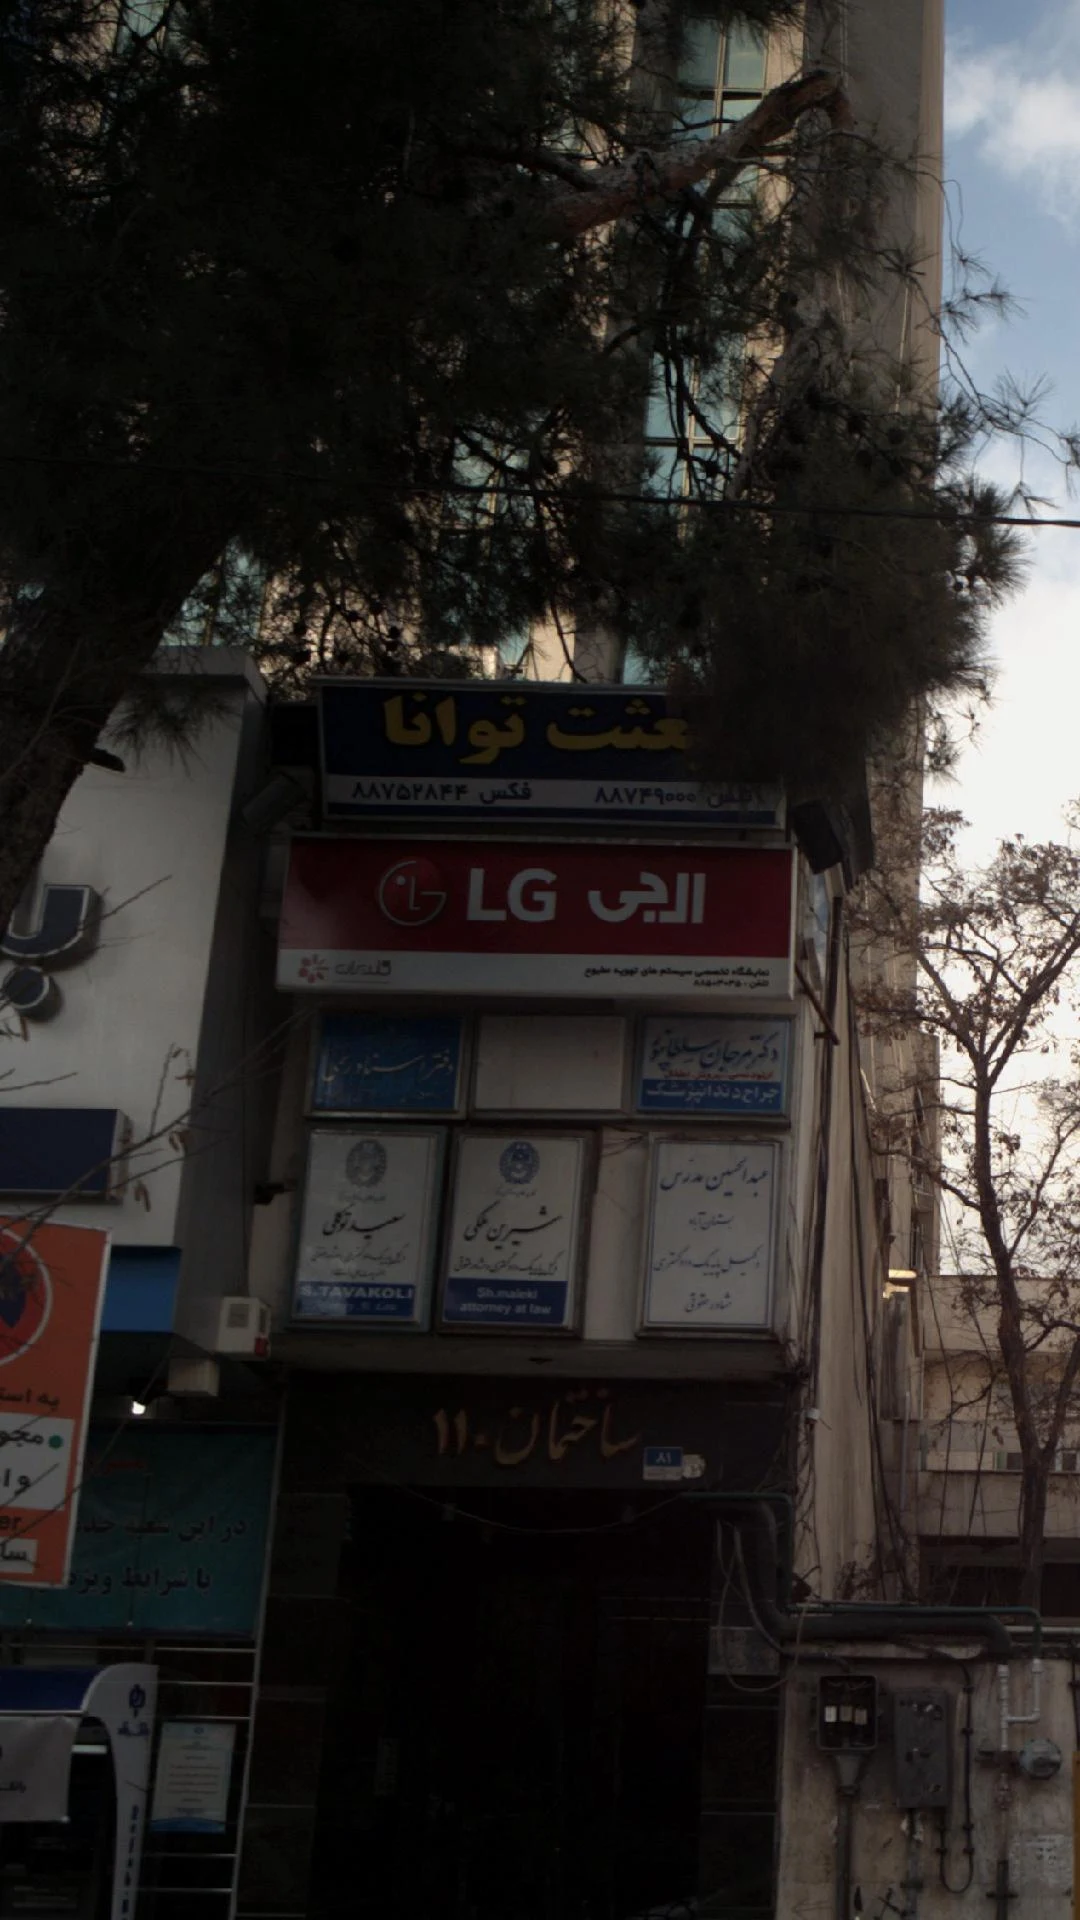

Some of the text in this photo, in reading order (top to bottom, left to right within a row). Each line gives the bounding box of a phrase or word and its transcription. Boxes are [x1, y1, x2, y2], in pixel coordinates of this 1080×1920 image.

[382, 691, 525, 764] توانا
[479, 782, 532, 804] فکس
[466, 867, 557, 923] LG
[486, 1205, 563, 1250] شیرین
[460, 1302, 512, 1315] attorney
[494, 1387, 641, 1466] ساختمان
